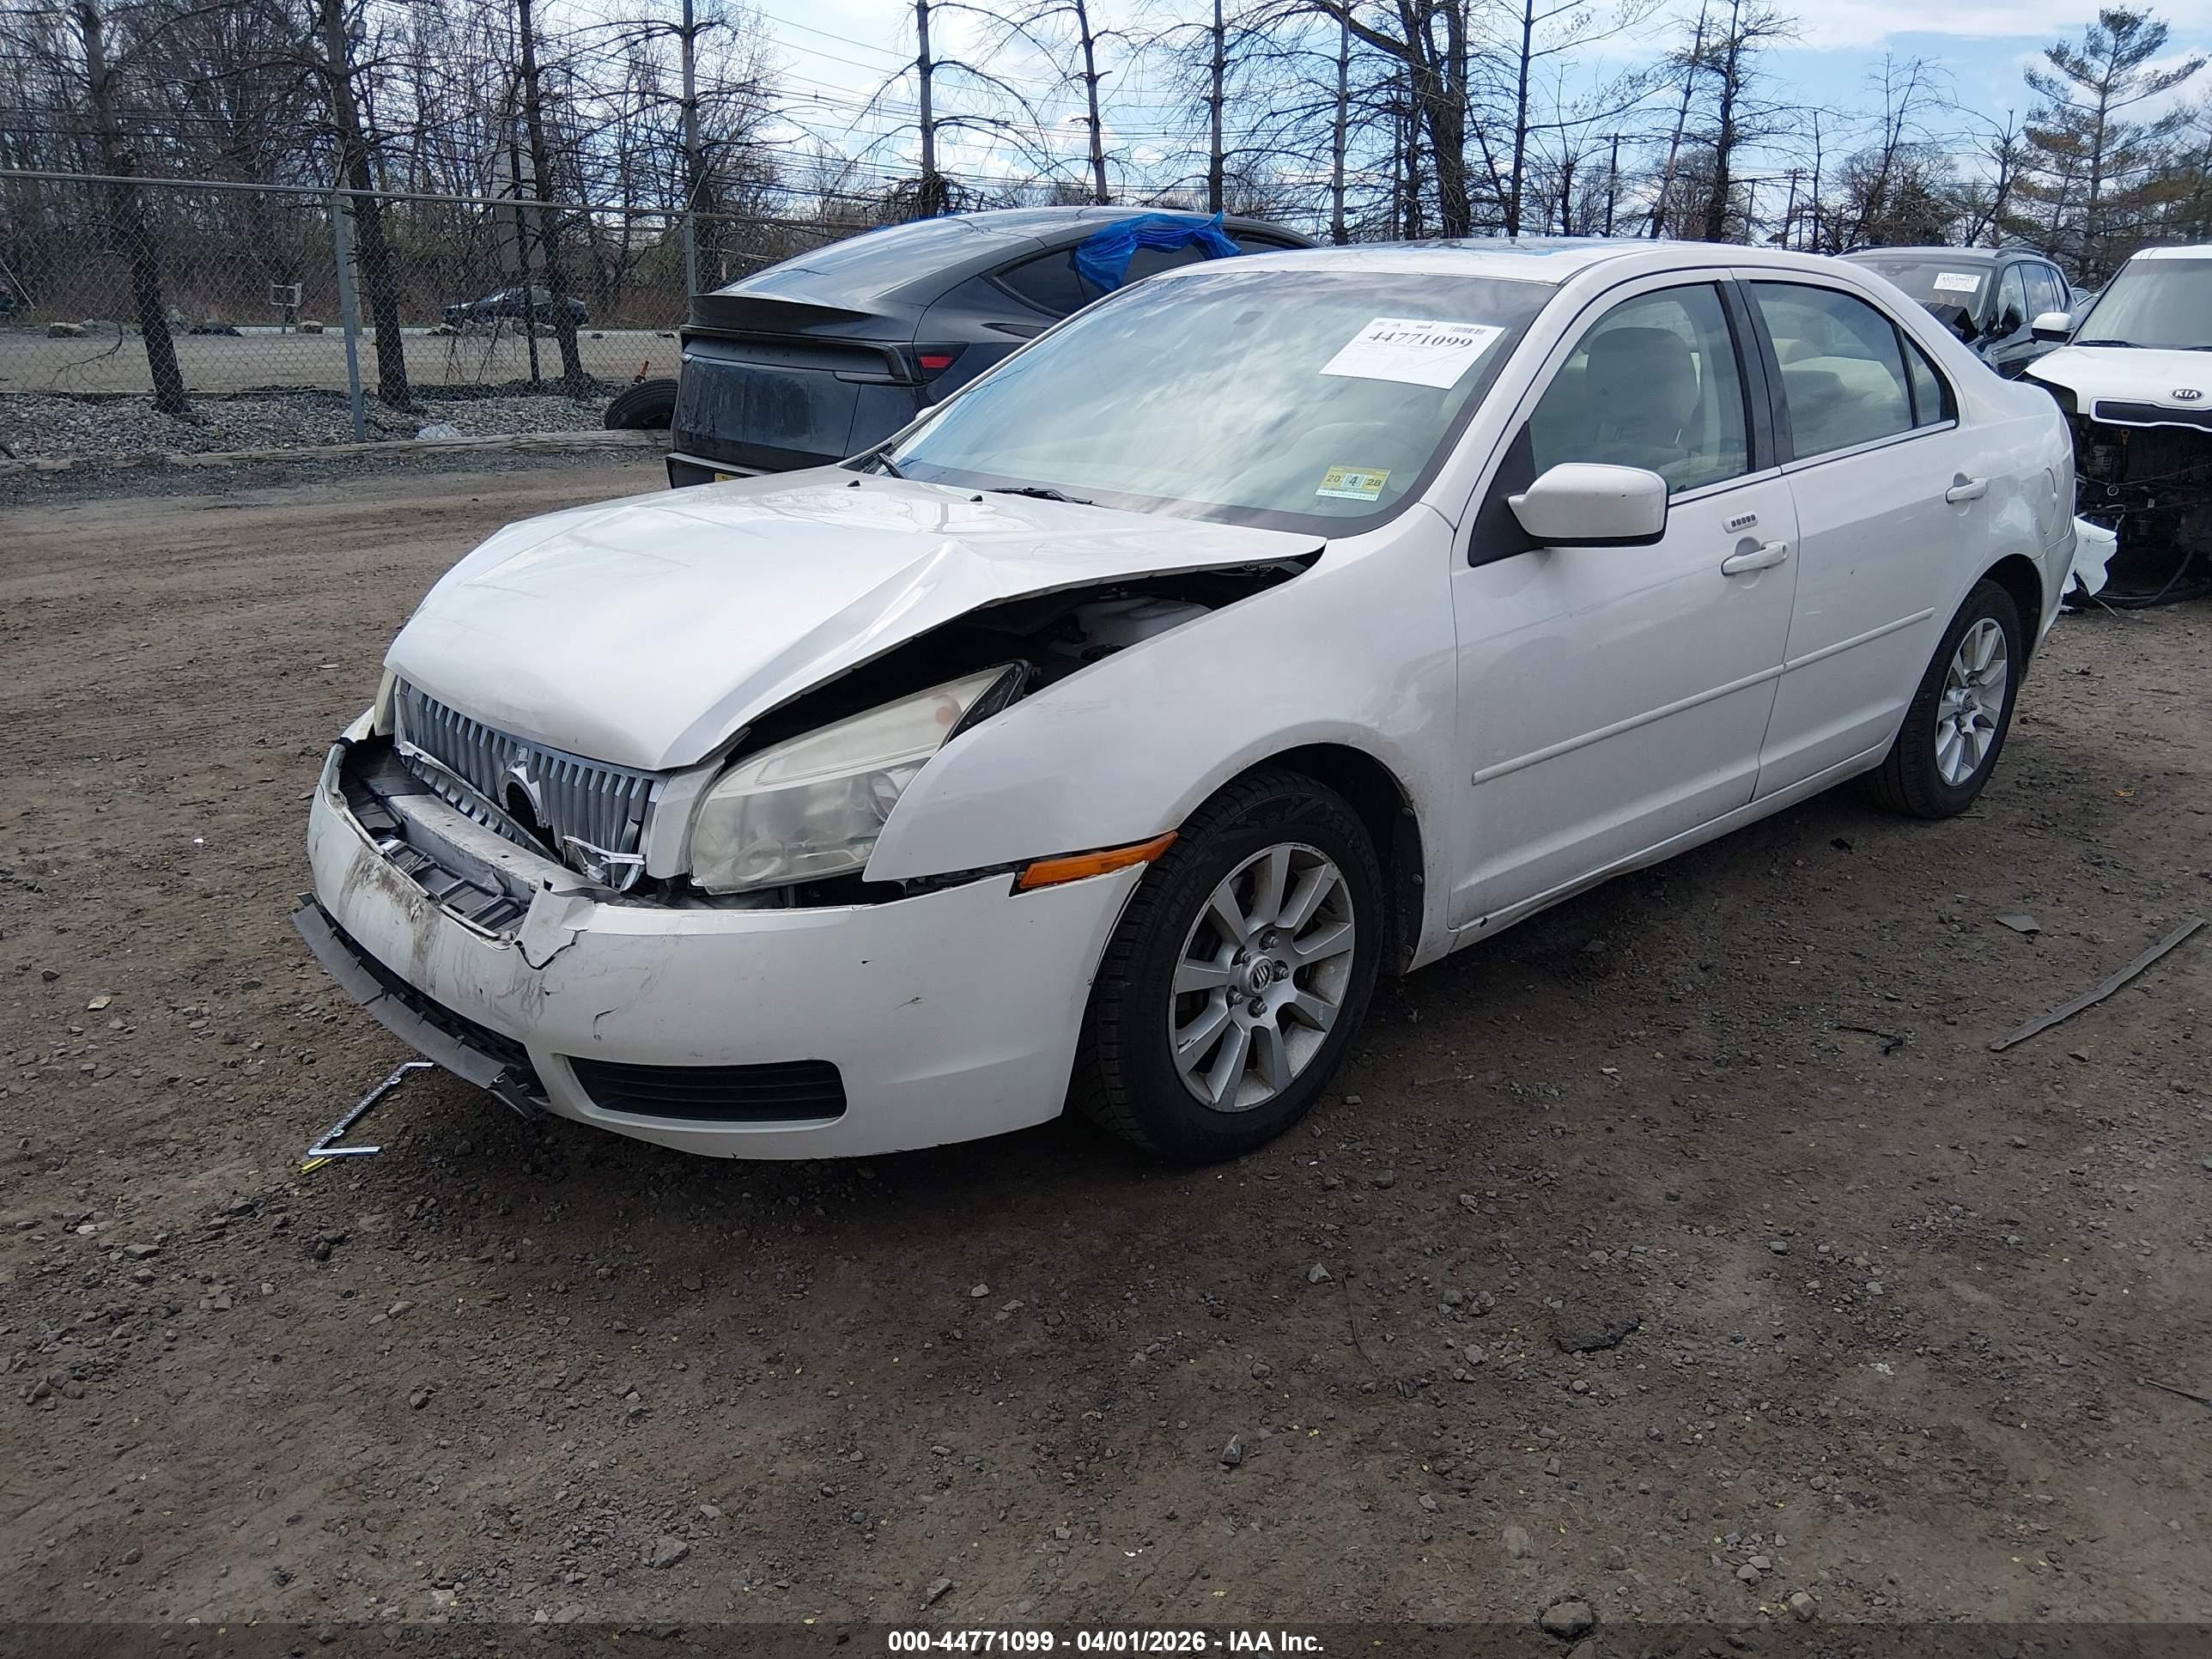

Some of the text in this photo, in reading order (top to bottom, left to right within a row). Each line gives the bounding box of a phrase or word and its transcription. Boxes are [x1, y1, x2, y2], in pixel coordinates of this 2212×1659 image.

[1368, 331, 1474, 349] 44771099
[2175, 389, 2198, 398] KIA
[1348, 475, 1358, 487] 4
[1366, 478, 1382, 487] 28
